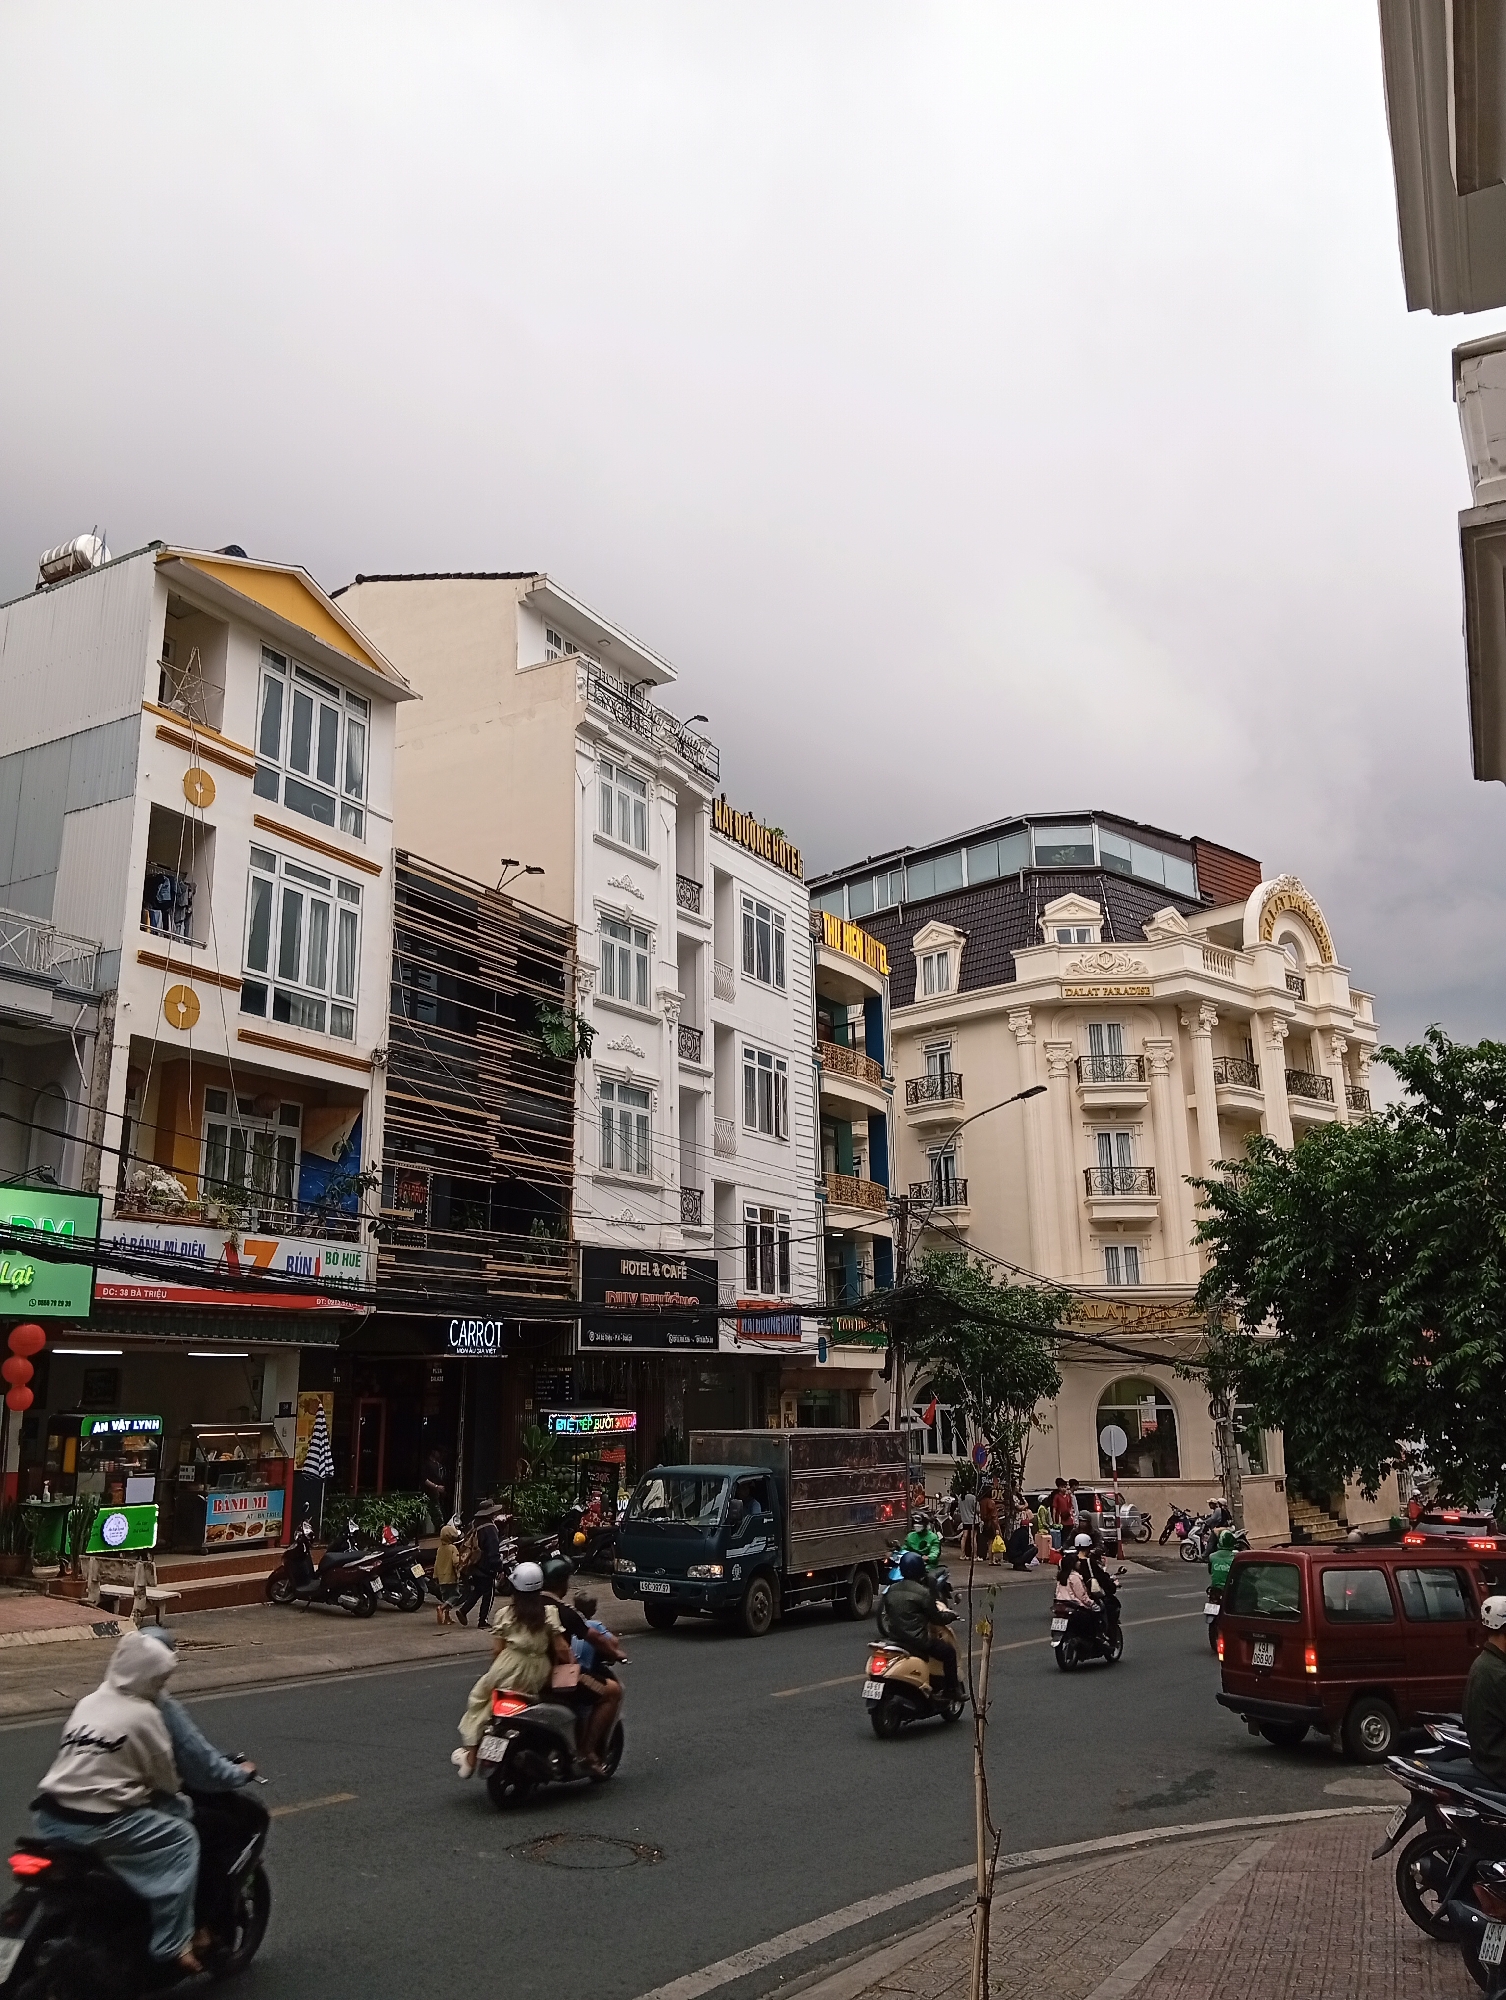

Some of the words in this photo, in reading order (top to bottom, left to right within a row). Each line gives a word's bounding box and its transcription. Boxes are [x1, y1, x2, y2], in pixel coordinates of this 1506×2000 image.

[772, 834, 803, 879] HOTEL
[1065, 988, 1100, 997] DALAT
[1102, 986, 1150, 996] PARADISE
[286, 1252, 312, 1275] BÚN
[621, 1260, 651, 1276] HOTEL
[652, 1263, 660, 1277] &
[661, 1261, 688, 1280] CAFÉ
[131, 1288, 142, 1297] BÀ
[144, 1289, 167, 1299] TRIỆU
[1072, 1304, 1130, 1319] ALAT
[449, 1319, 504, 1348] CARROT
[133, 1420, 159, 1430] LYNH
[213, 1494, 248, 1512] BÁNH
[251, 1492, 267, 1509] MÌ
